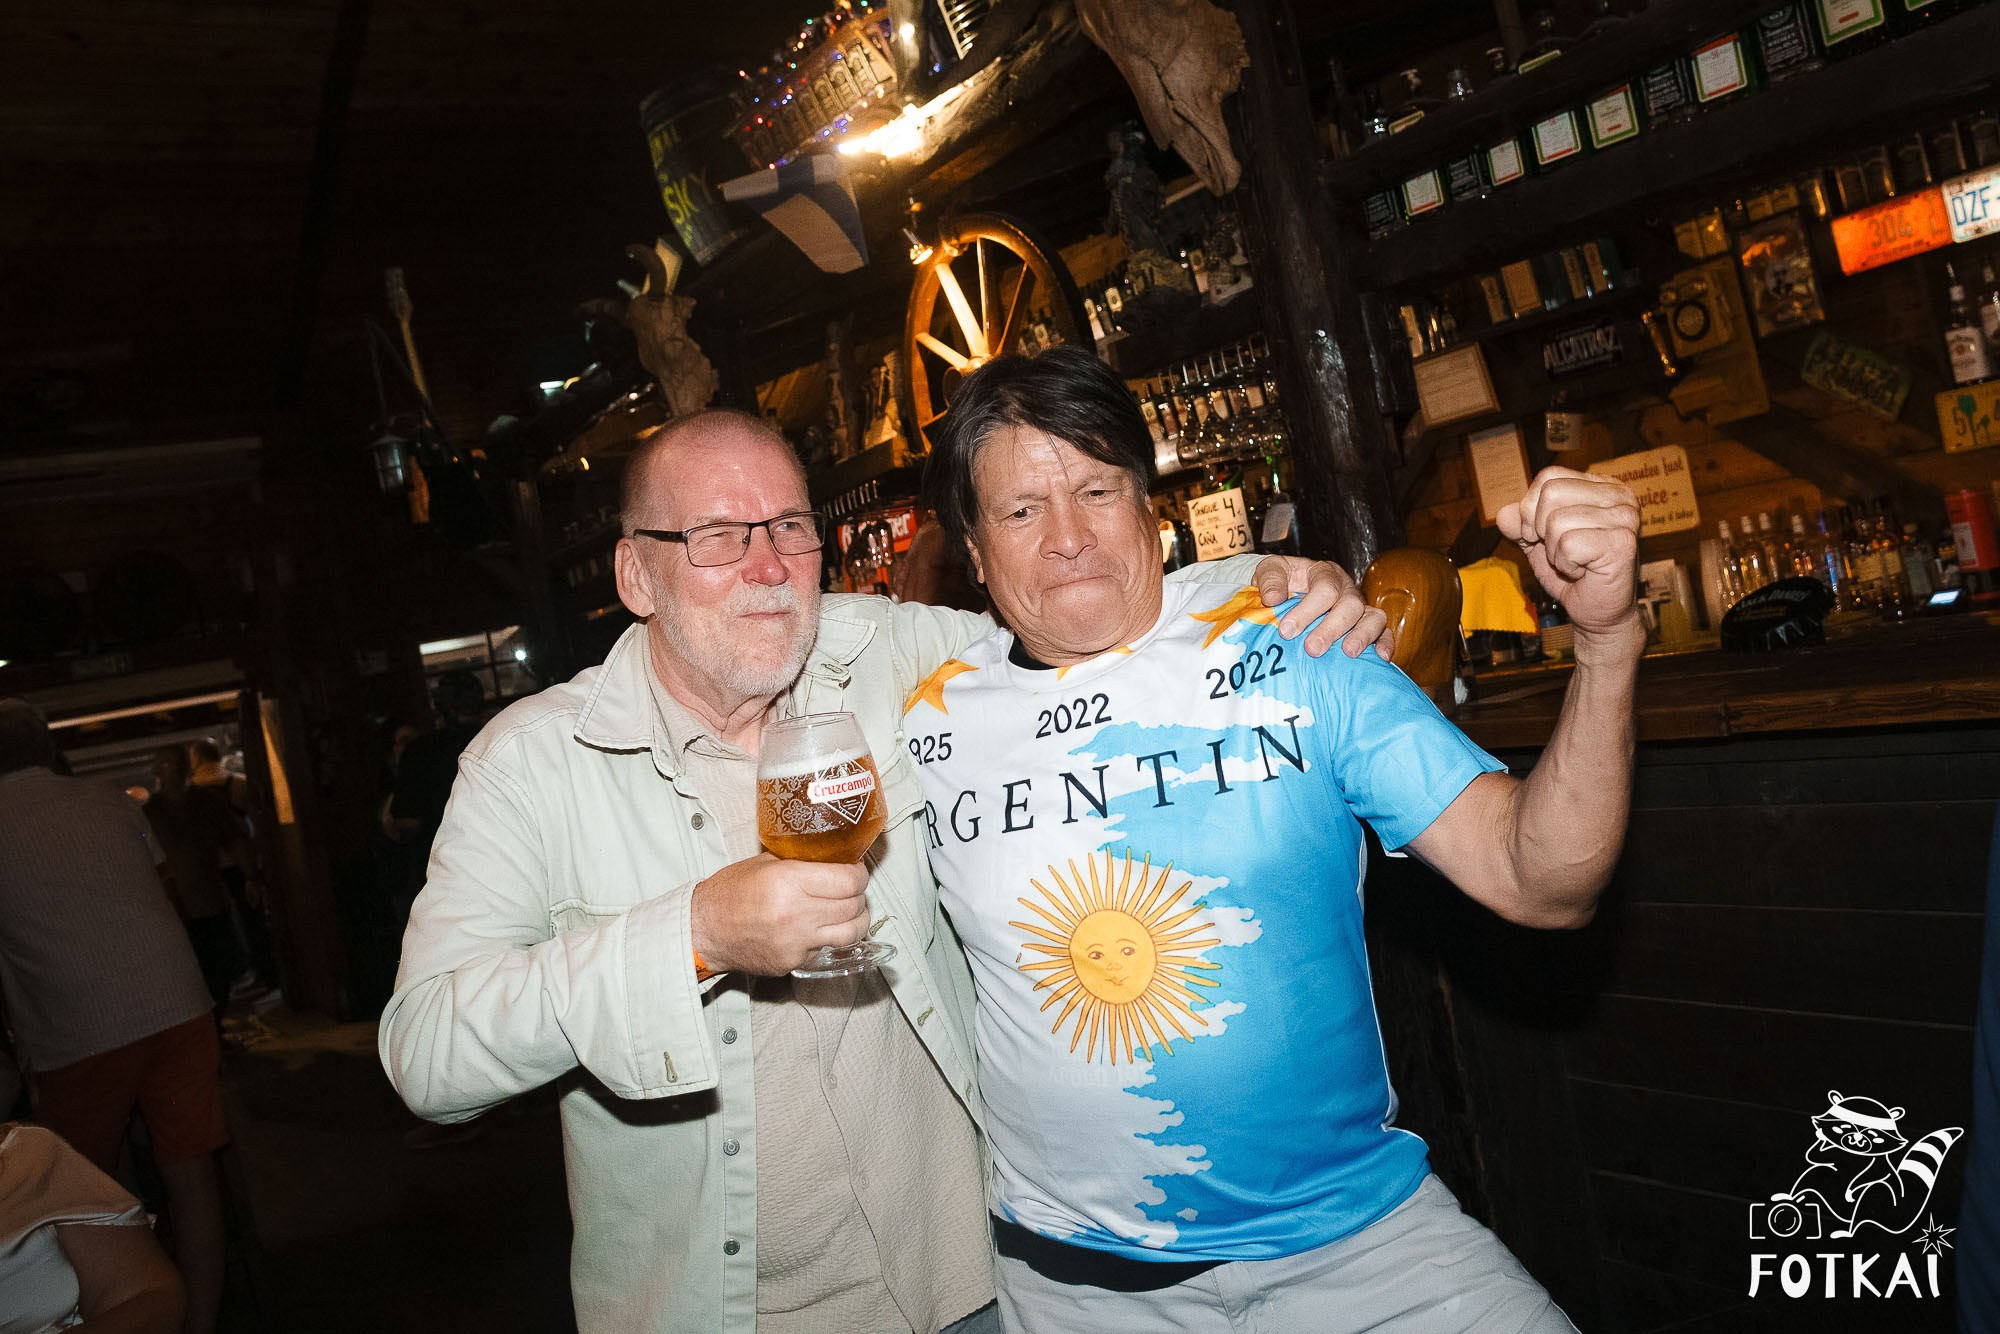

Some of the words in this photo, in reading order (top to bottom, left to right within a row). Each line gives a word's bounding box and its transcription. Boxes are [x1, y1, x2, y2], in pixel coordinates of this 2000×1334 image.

[1544, 325, 1622, 370] ALCATRAZ
[1638, 487, 1668, 508] vice
[1205, 643, 1287, 700] 2022
[1035, 692, 1112, 739] 2022
[908, 732, 952, 765] 925
[813, 774, 873, 798] Cruzcampo
[923, 714, 1305, 850] RGENTIN
